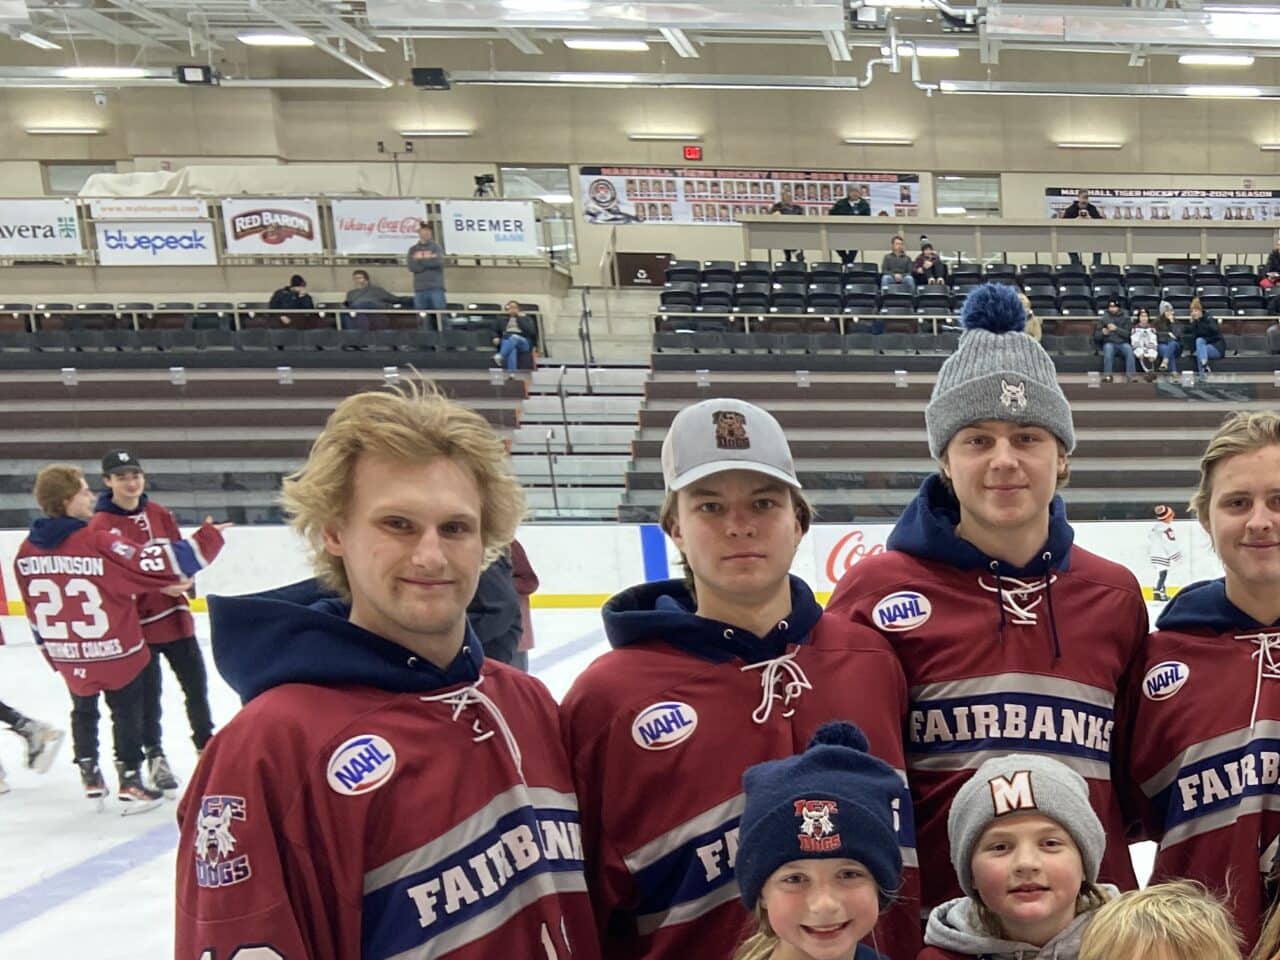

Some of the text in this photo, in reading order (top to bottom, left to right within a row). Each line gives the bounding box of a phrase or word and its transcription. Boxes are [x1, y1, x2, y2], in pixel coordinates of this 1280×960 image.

[1061, 189, 1112, 197] MARHALL
[234, 211, 310, 233] RED BARON
[455, 219, 524, 233] BREMER
[104, 229, 207, 255] bluepeak
[28, 578, 109, 640] 23
[878, 597, 927, 626] NAHL
[1146, 667, 1184, 695] NAHL
[638, 707, 694, 746] NAHL
[910, 703, 1115, 752] FAIRBANKS
[334, 743, 391, 791] NAHL
[988, 770, 1038, 817] M
[201, 795, 246, 822] CE
[195, 854, 252, 889] DOGS
